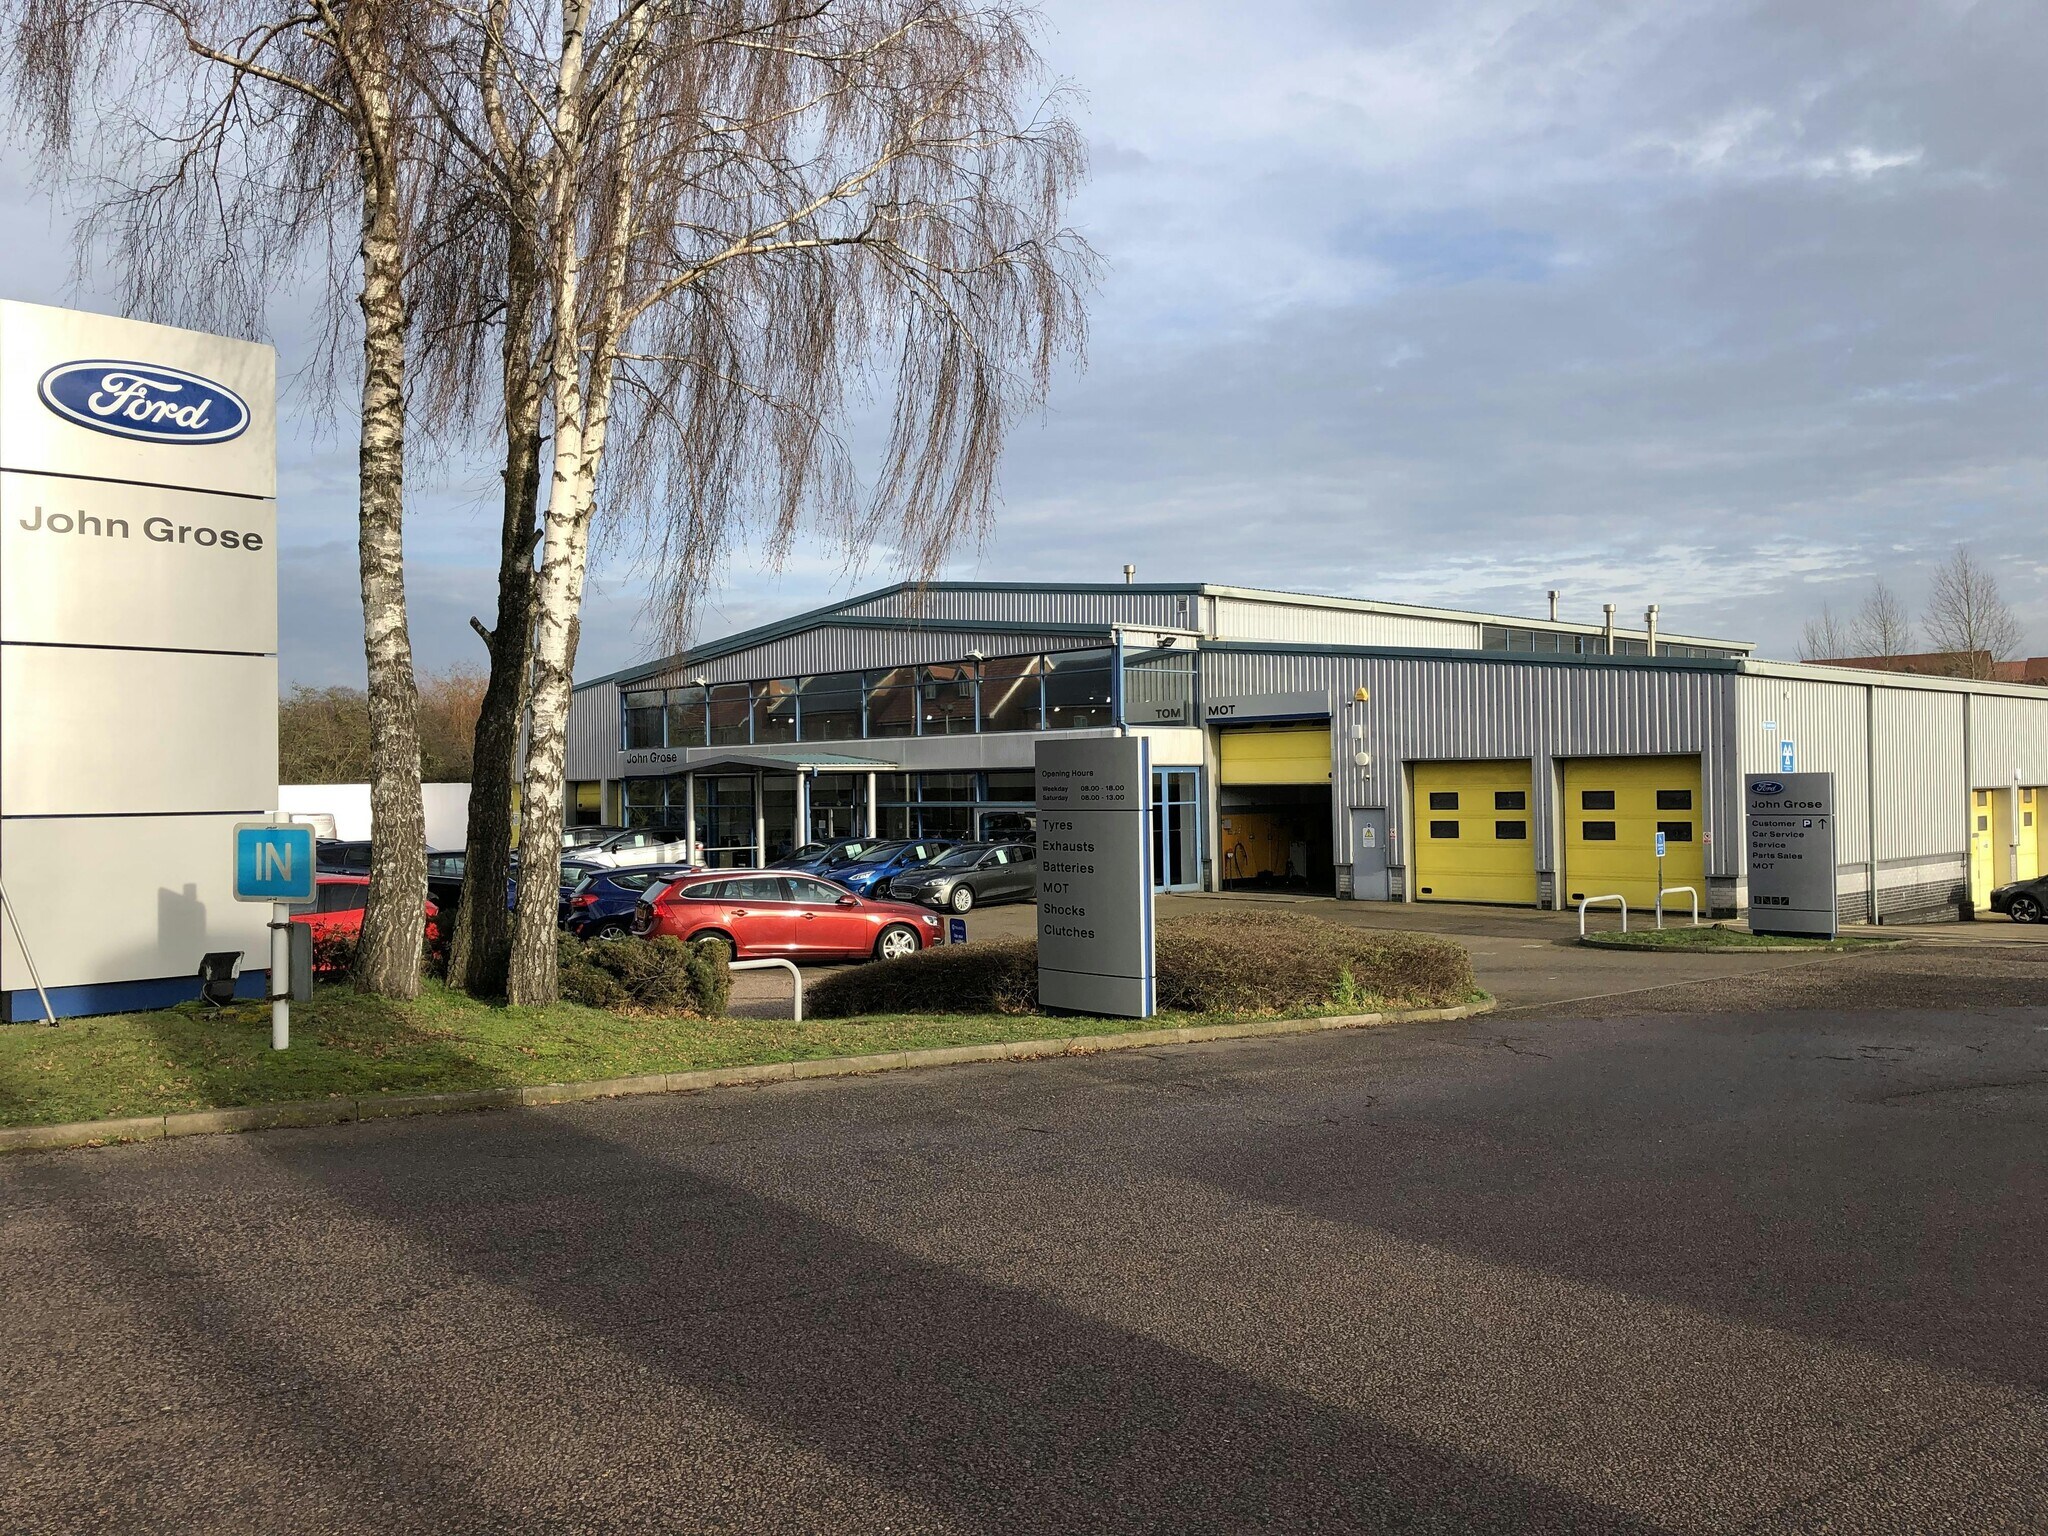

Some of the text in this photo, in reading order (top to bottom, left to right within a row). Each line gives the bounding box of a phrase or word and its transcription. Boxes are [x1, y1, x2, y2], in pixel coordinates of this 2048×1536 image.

[88, 373, 213, 429] Ford
[19, 506, 264, 551] John Grose
[1208, 705, 1236, 716] MOT
[627, 752, 677, 764] John Grose
[1042, 770, 1070, 778] Opening
[1756, 782, 1777, 792] Ford
[1783, 800, 1823, 808] Grose
[1042, 820, 1073, 832] Tyres
[1042, 841, 1095, 852] Exhausts
[255, 842, 292, 881] IN
[1042, 862, 1094, 873] Batteries
[1043, 883, 1069, 894] MOT
[1043, 904, 1086, 916] Shocks
[1044, 925, 1095, 938] Clutches
